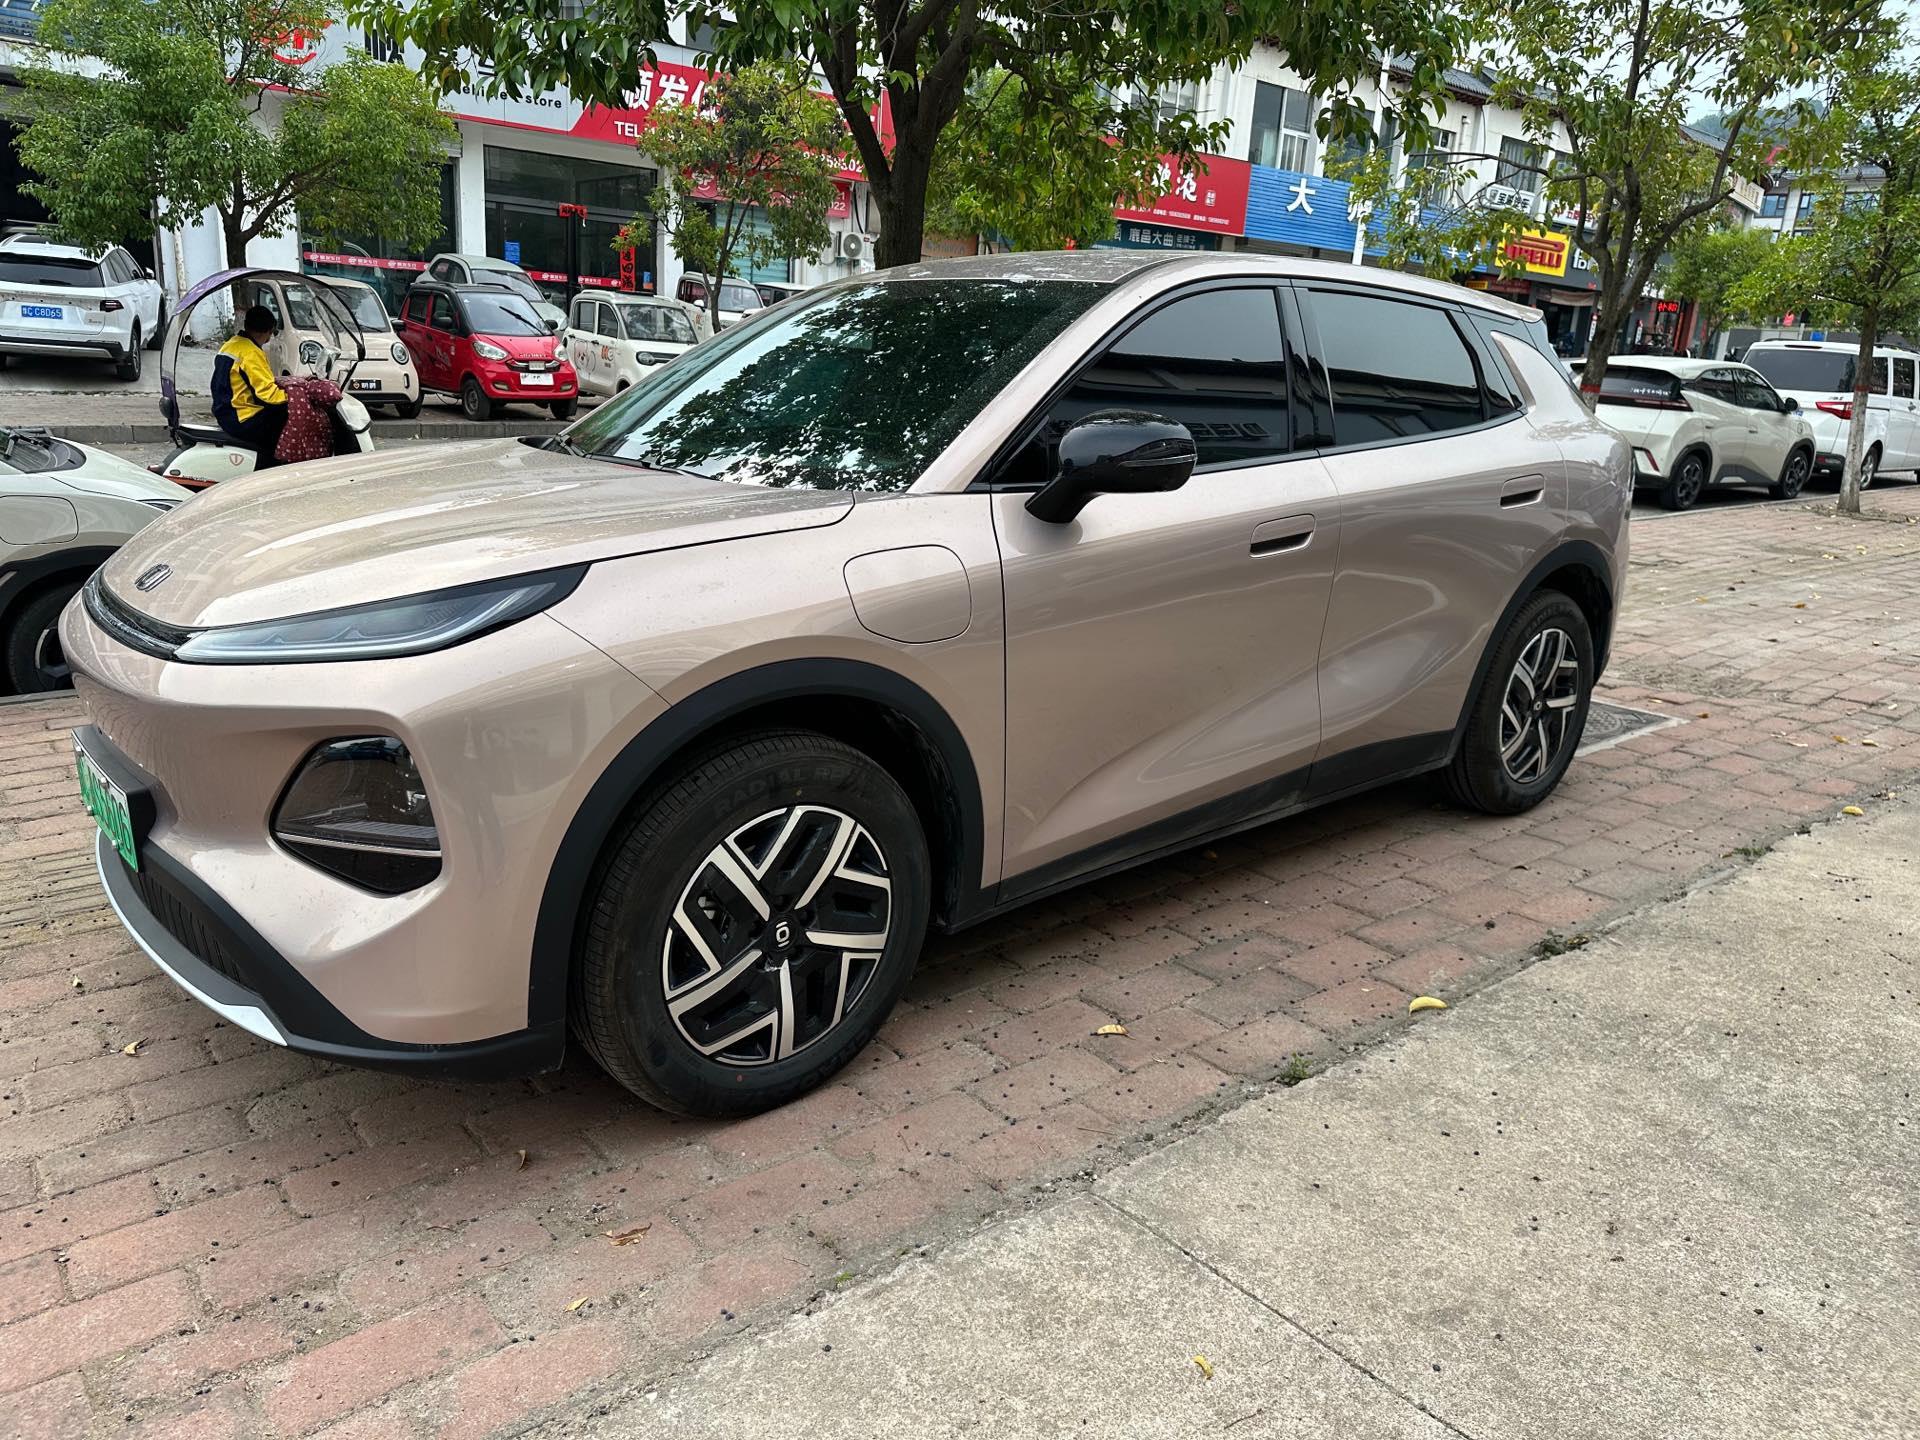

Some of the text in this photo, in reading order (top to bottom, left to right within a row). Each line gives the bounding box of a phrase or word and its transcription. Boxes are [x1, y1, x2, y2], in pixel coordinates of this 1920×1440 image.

[525, 93, 562, 109] store
[1129, 227, 1174, 248] 鹿邑大曲
